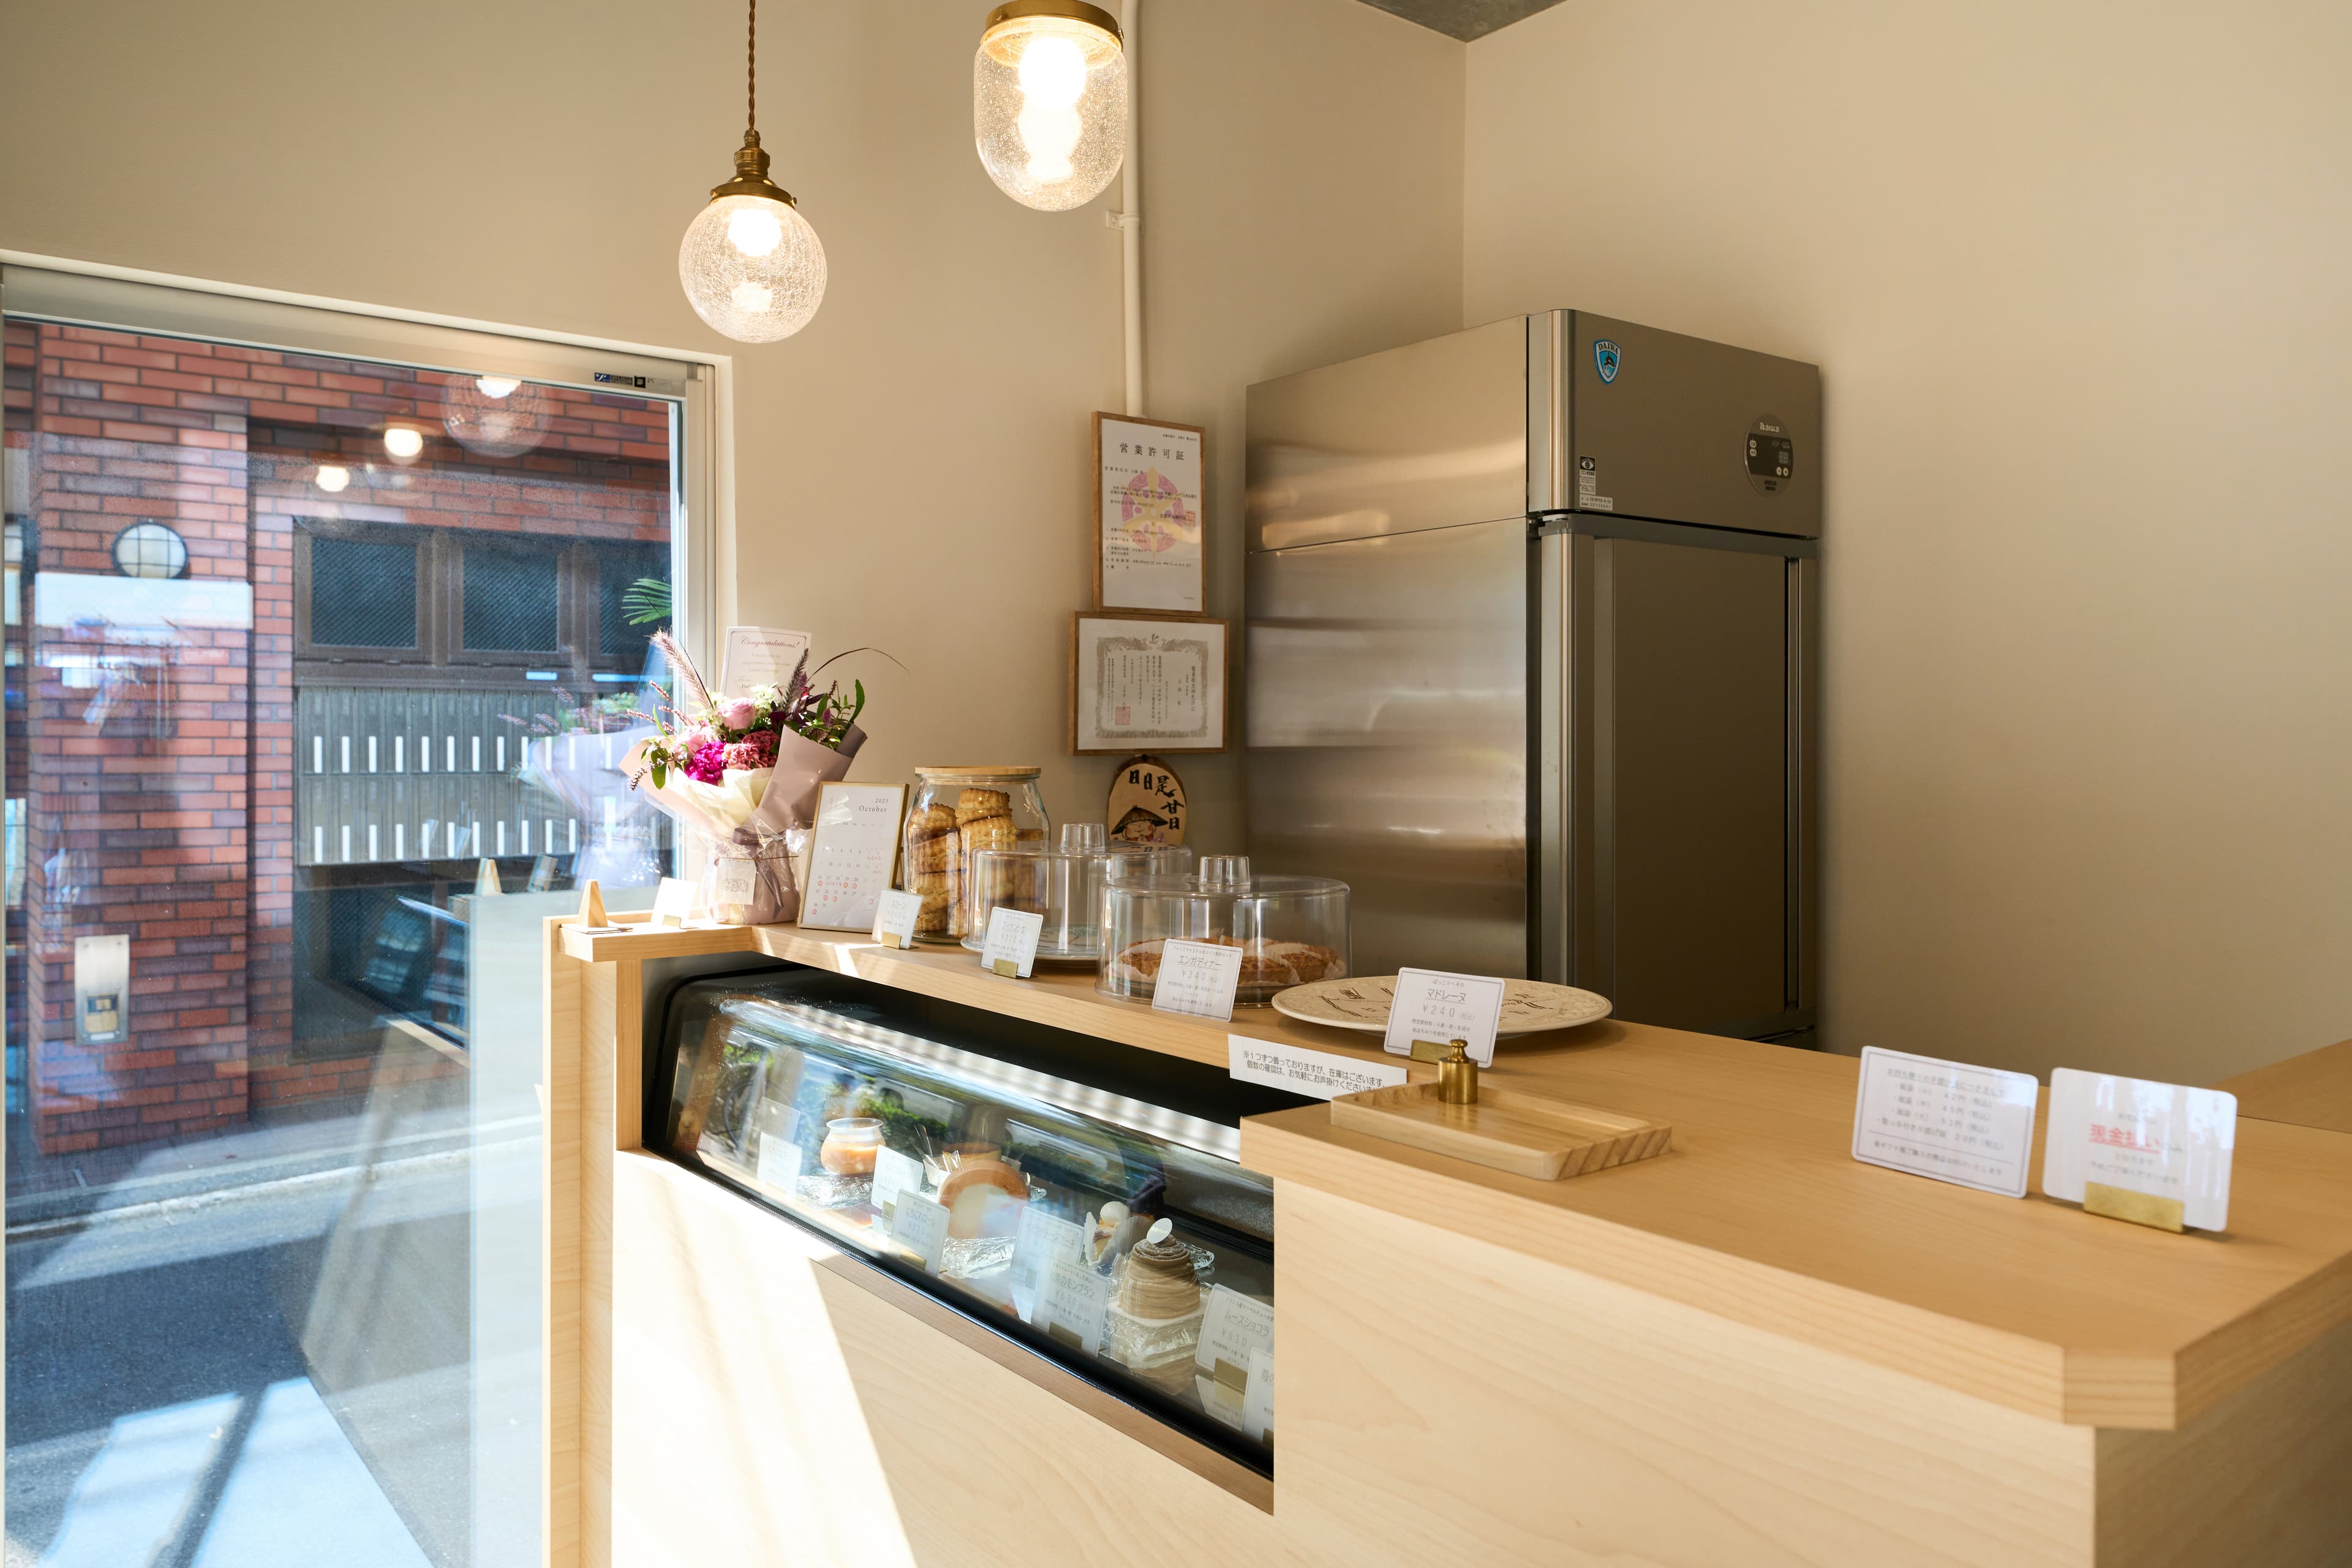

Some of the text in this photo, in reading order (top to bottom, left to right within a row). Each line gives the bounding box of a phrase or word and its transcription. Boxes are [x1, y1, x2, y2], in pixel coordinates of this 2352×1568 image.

[1597, 342, 1618, 355] DAIWA
[1119, 442, 1185, 461] 営業許可証
[740, 636, 801, 649] Congratulations!
[1178, 955, 1222, 968] エンガディナー
[1182, 970, 1206, 981] ¥340
[1427, 989, 1467, 1002] マドレーヌ
[1422, 1004, 1455, 1017] ¥240
[1225, 1310, 1270, 1336] ムースショコラ
[1221, 1327, 1248, 1348] ¥510
